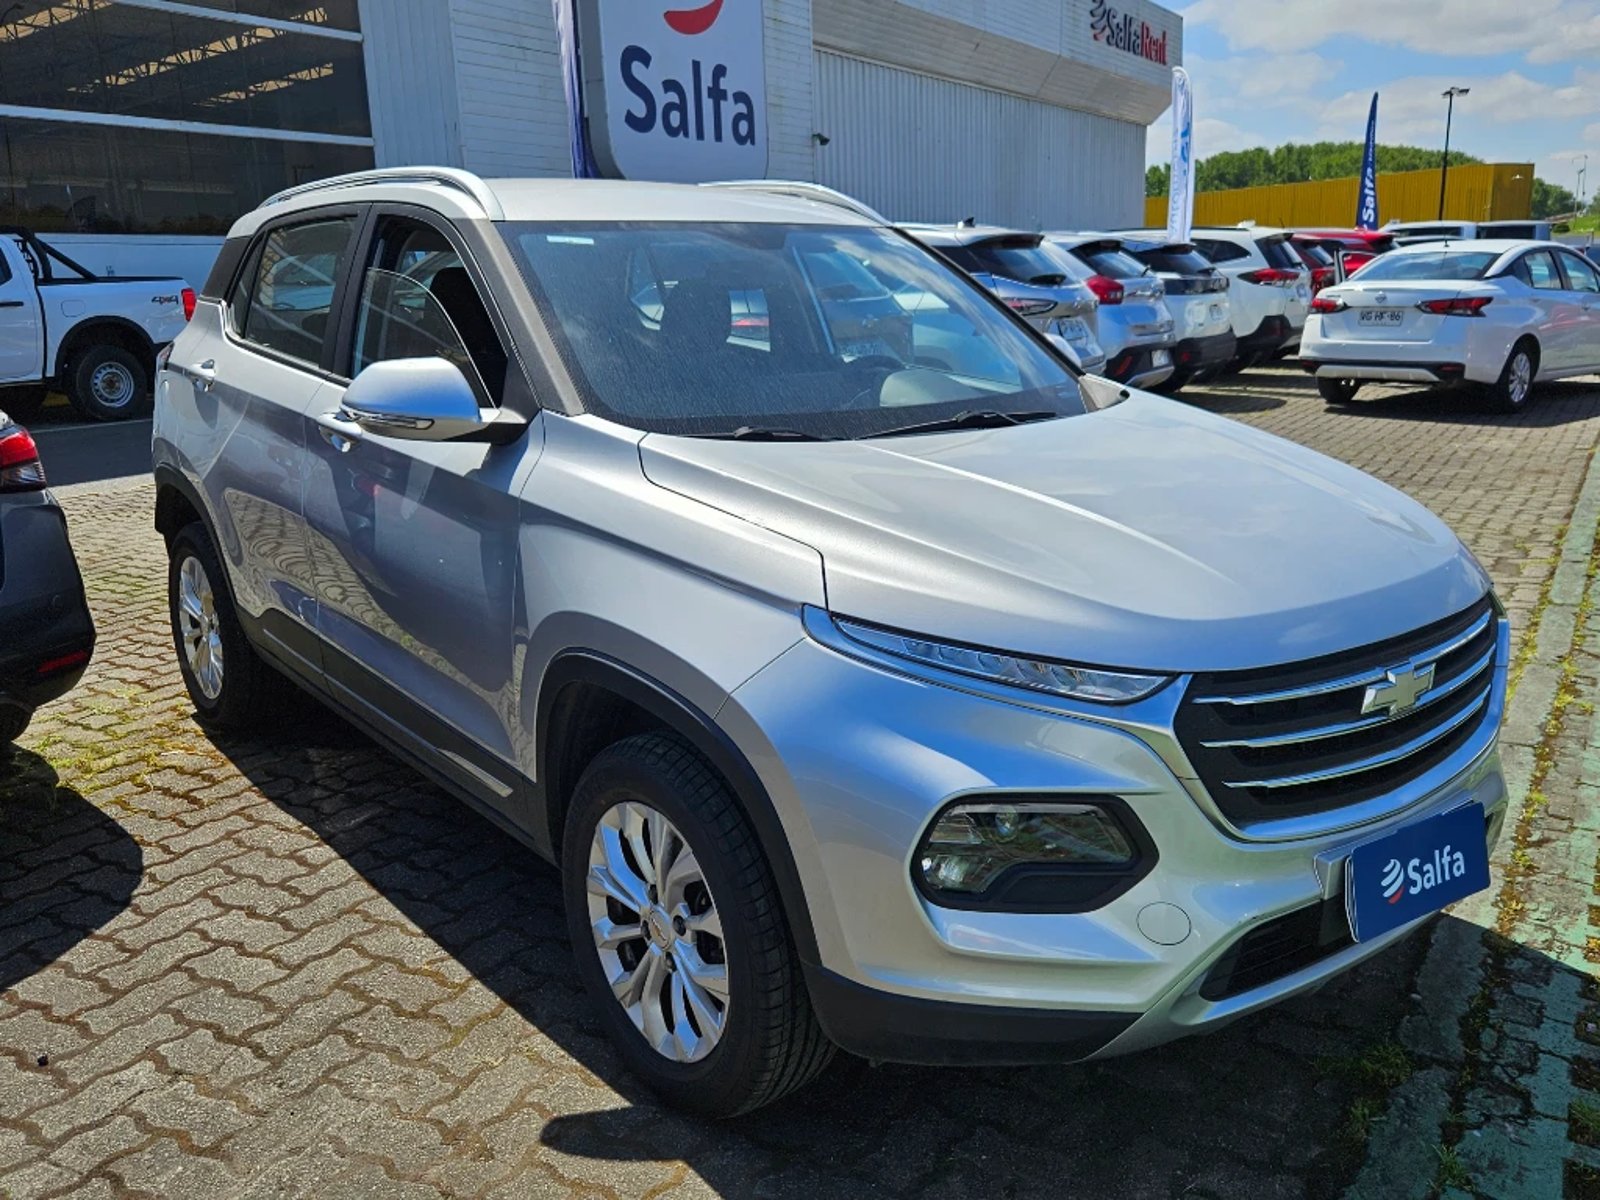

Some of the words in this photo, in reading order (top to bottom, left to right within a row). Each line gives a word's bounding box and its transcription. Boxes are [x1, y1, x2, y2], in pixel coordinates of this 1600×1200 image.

[1106, 7, 1167, 66] SalfaRent
[620, 44, 756, 146] Salfa
[1407, 844, 1466, 895] Salfa
